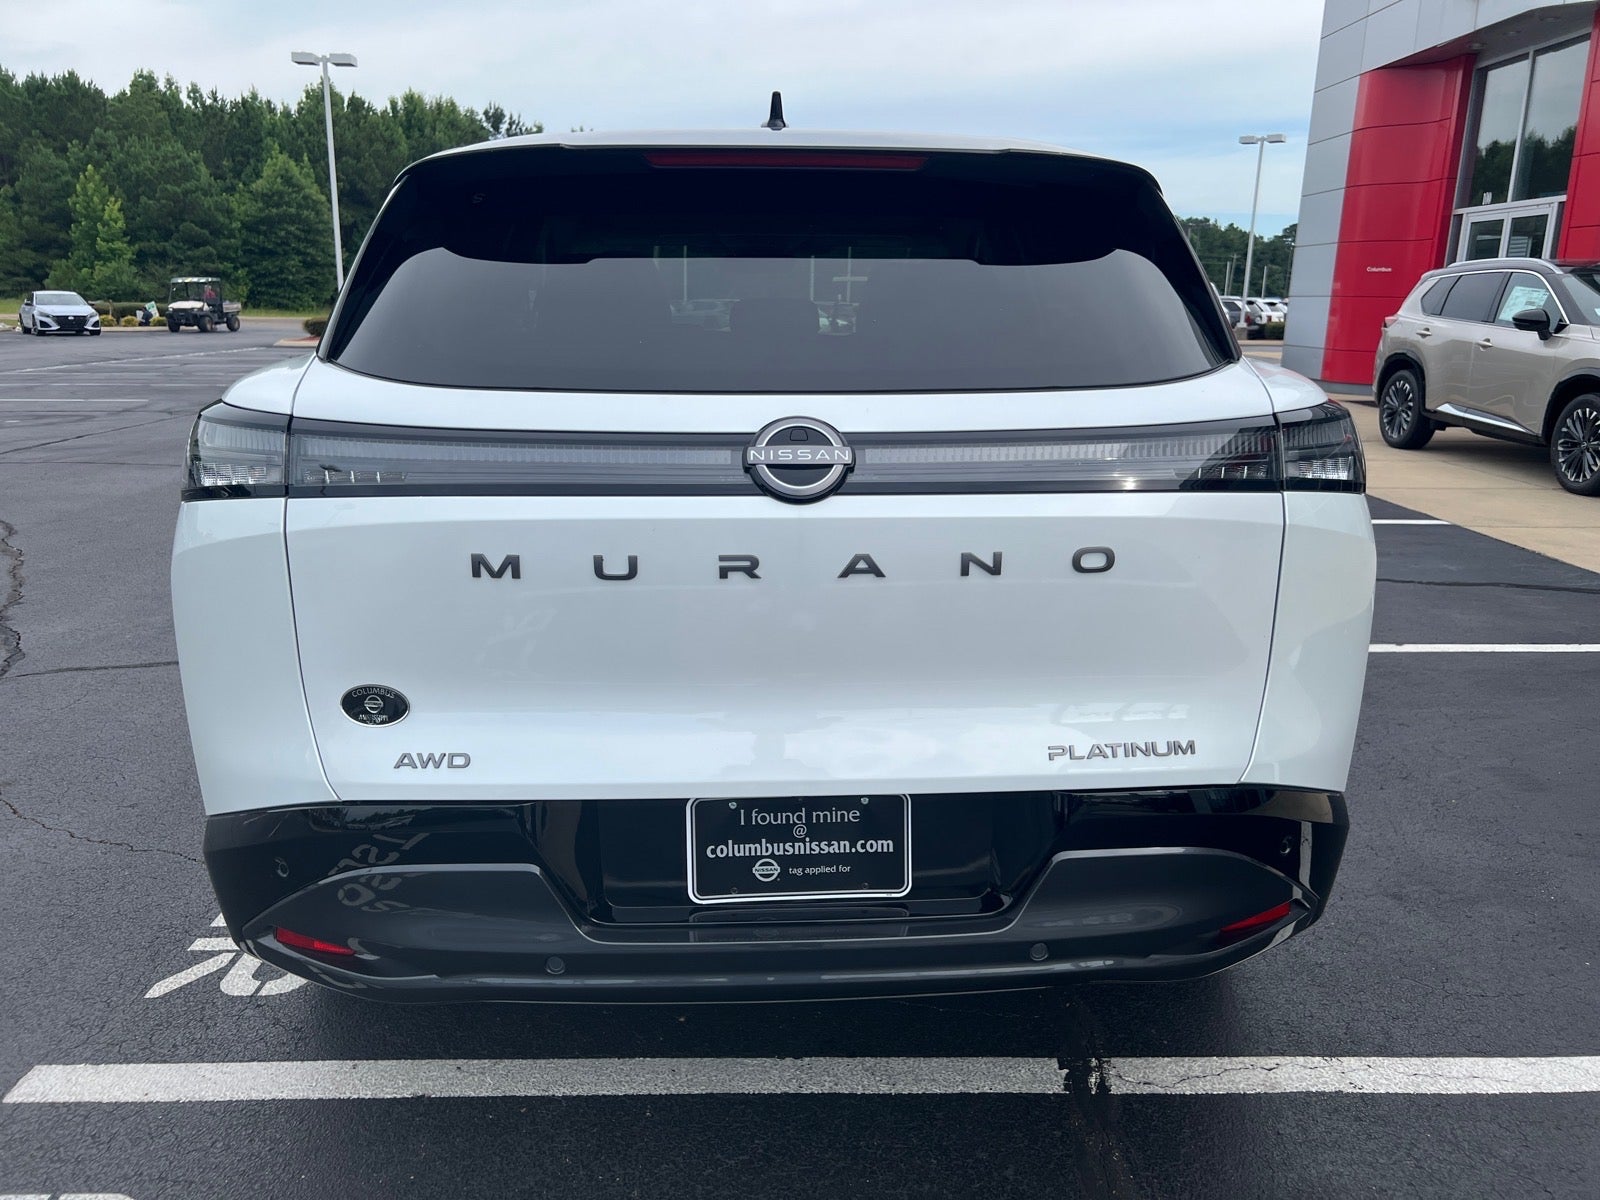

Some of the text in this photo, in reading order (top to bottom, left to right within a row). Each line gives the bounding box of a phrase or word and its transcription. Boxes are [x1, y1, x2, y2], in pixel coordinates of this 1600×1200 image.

[750, 449, 849, 461] NISSAN
[471, 546, 1116, 581] MURANO
[351, 687, 397, 699] COLUMBUS
[1047, 740, 1196, 761] PLATINUM
[393, 752, 471, 769] AWD
[740, 807, 861, 825] I found mine
[793, 824, 807, 838] @
[706, 837, 894, 858] columbusnissan.com
[789, 864, 851, 876] tag applied for
